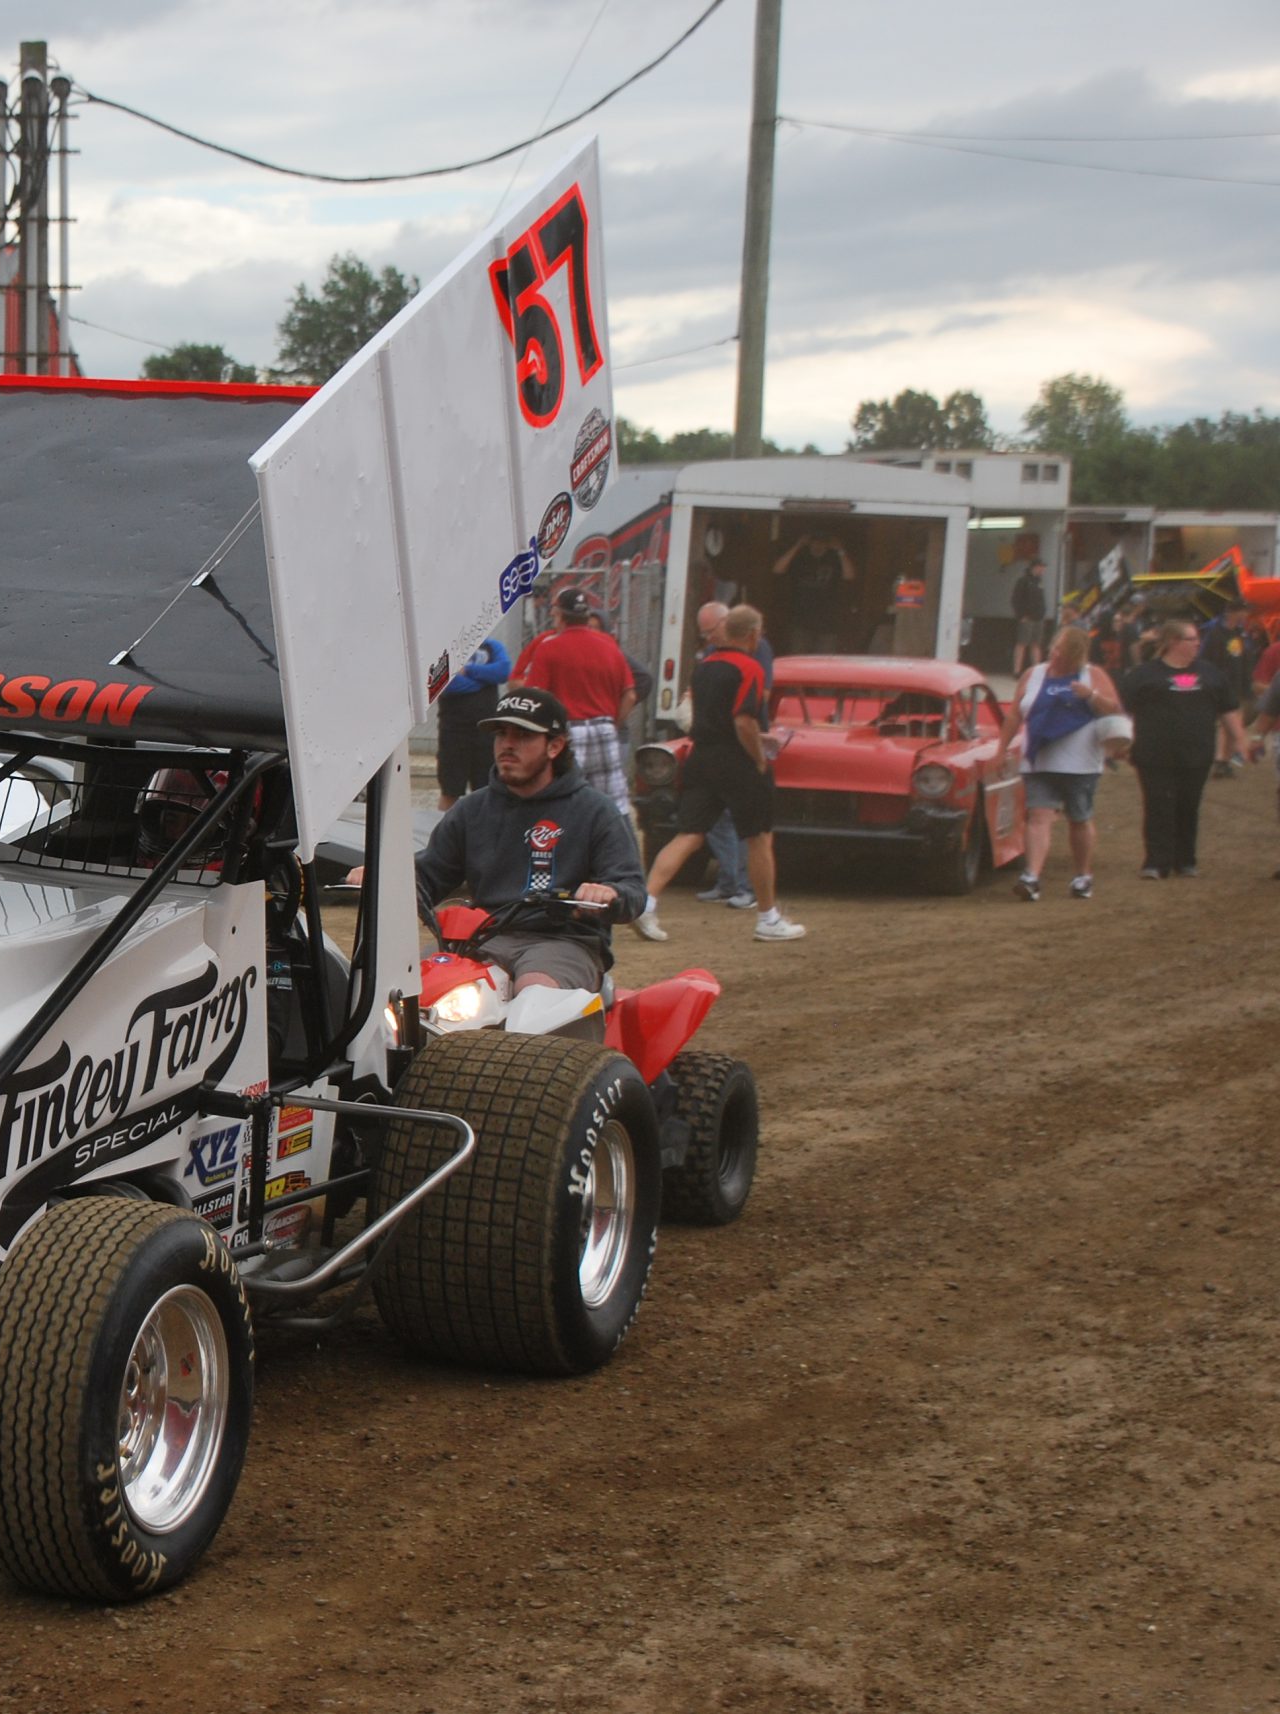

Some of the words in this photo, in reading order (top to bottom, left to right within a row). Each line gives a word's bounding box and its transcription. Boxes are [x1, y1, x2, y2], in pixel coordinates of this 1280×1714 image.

[488, 182, 604, 428] 57
[74, 1105, 182, 1168] SPECIAL
[184, 1123, 242, 1178] XYZ
